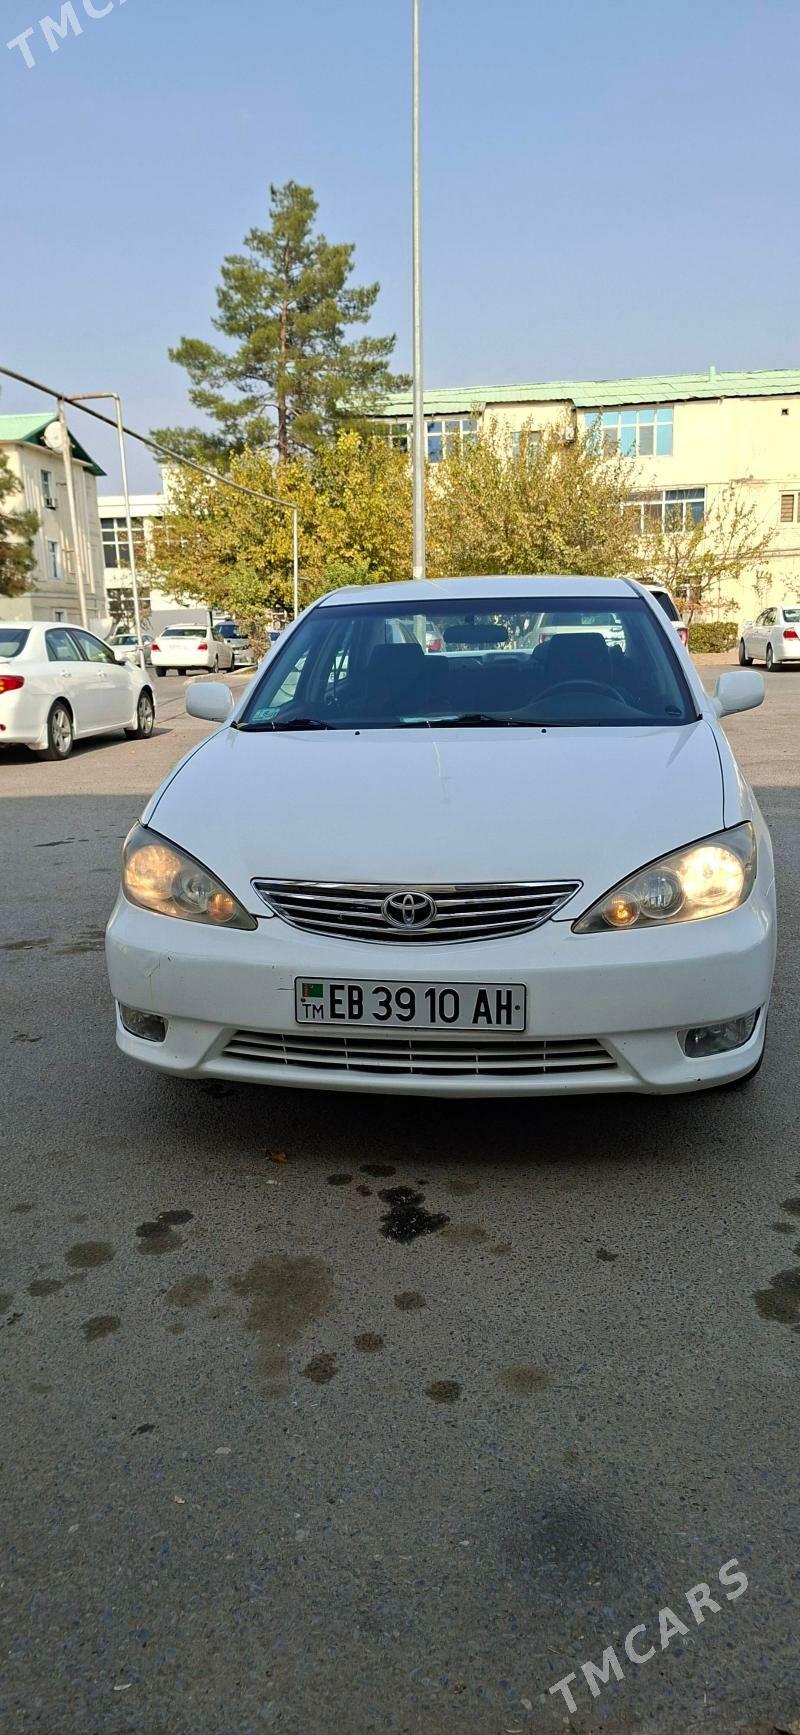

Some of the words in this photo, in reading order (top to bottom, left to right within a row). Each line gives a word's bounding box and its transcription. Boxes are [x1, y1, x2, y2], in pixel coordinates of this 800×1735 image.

[302, 1003, 324, 1019] TM
[329, 984, 363, 1020] EB
[372, 986, 416, 1022] 39
[424, 988, 460, 1023] 10
[471, 989, 512, 1025] AH
